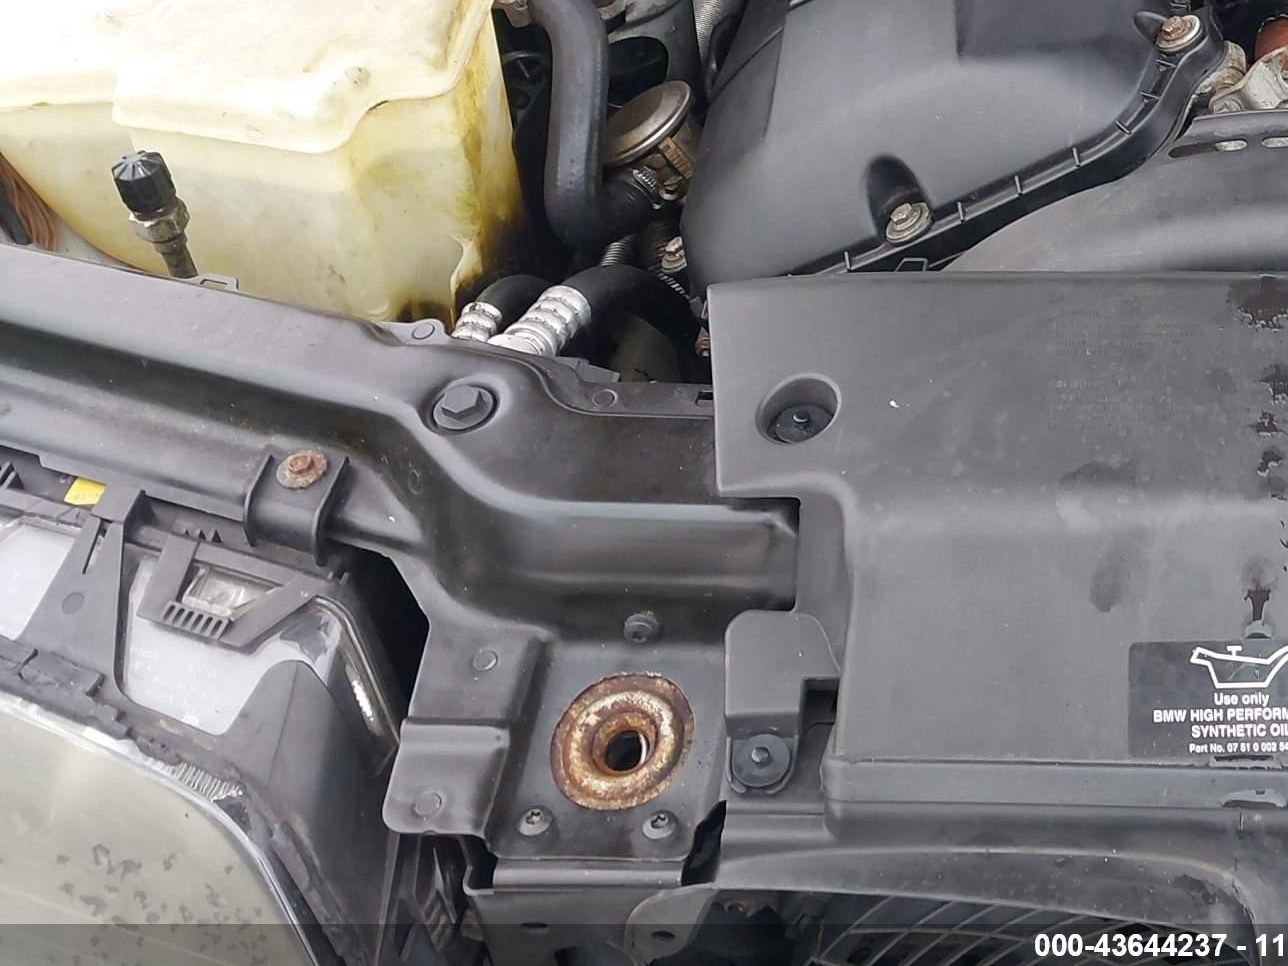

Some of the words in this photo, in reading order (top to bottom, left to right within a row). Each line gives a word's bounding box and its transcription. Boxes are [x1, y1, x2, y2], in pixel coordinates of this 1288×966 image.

[1214, 692, 1238, 705] Use
[1241, 692, 1270, 707] only
[1153, 709, 1187, 723] BMW
[1190, 708, 1223, 722] HIGH
[1191, 724, 1267, 739] SYNTHETIC
[1188, 743, 1208, 754] Part
[1209, 743, 1225, 754] No.
[1227, 742, 1239, 753] 07
[1253, 742, 1260, 752] 0
[1261, 741, 1277, 752] 002
